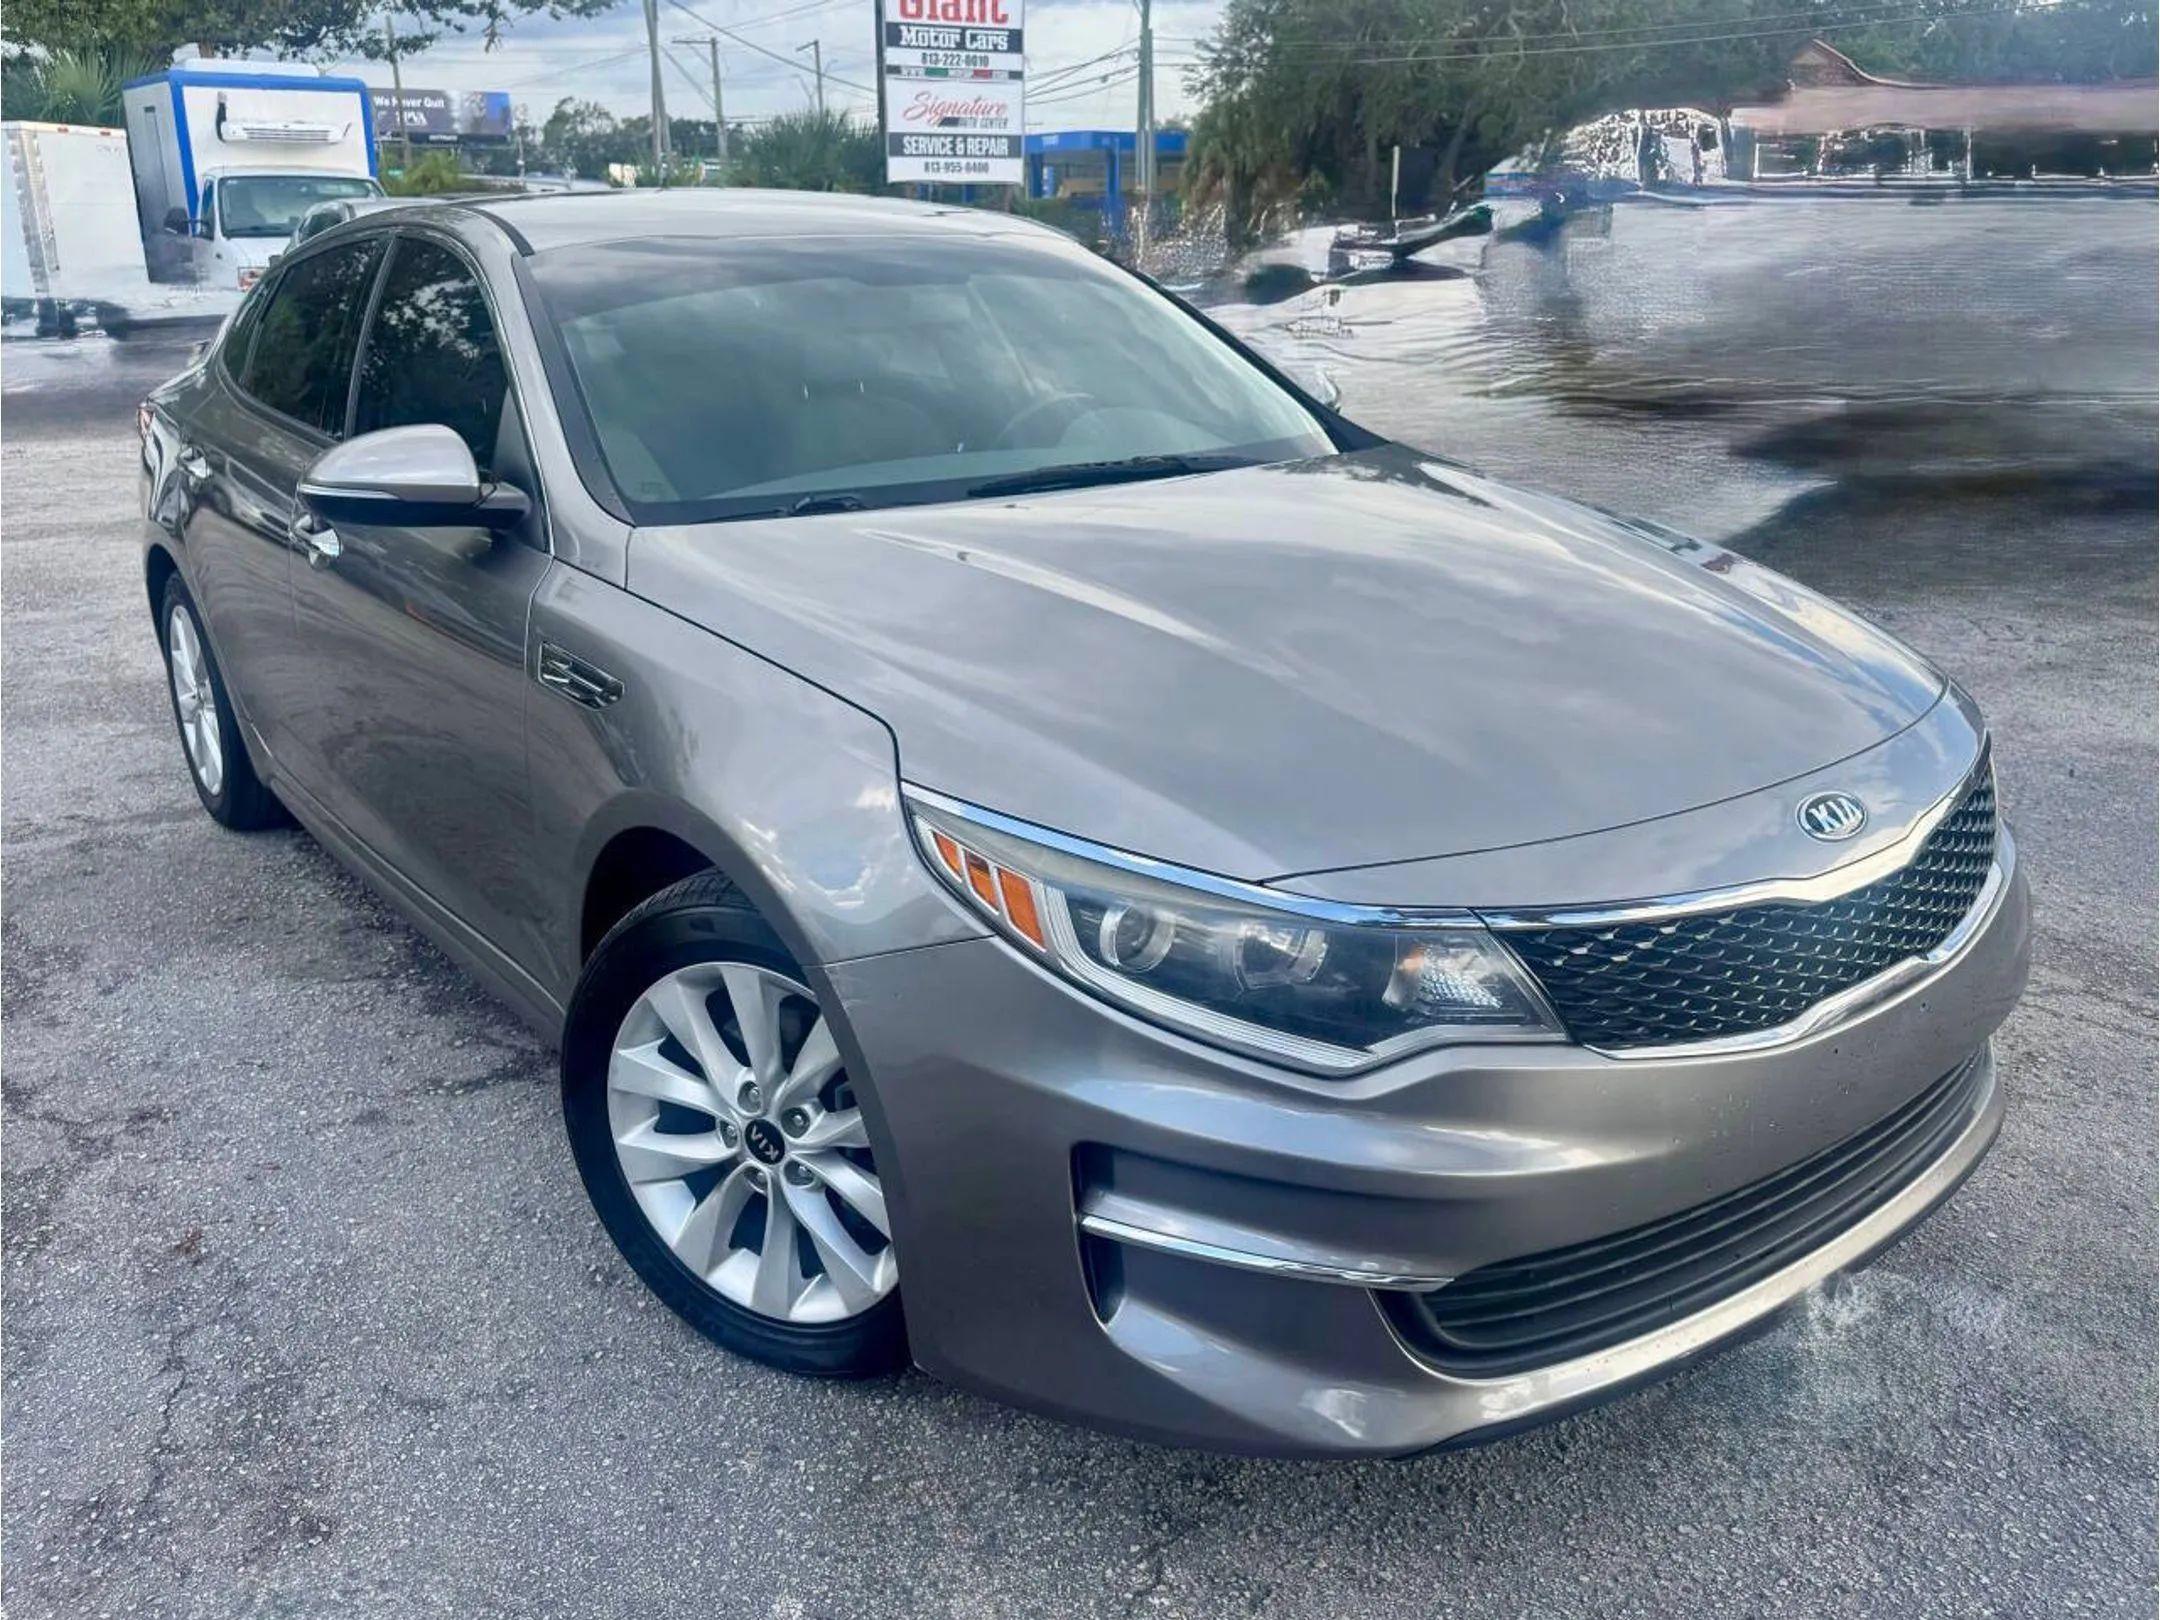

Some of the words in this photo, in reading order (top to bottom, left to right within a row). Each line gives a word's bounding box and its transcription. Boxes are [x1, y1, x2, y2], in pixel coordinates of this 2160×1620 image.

[899, 25, 961, 48] Motor
[965, 29, 1009, 50] Cars
[903, 91, 1008, 127] Signature
[902, 136, 954, 155] SERVICE
[956, 137, 965, 155] &
[967, 137, 1008, 156] REPAIR
[1808, 797, 1863, 833] KIA
[750, 1123, 780, 1161] KIA
